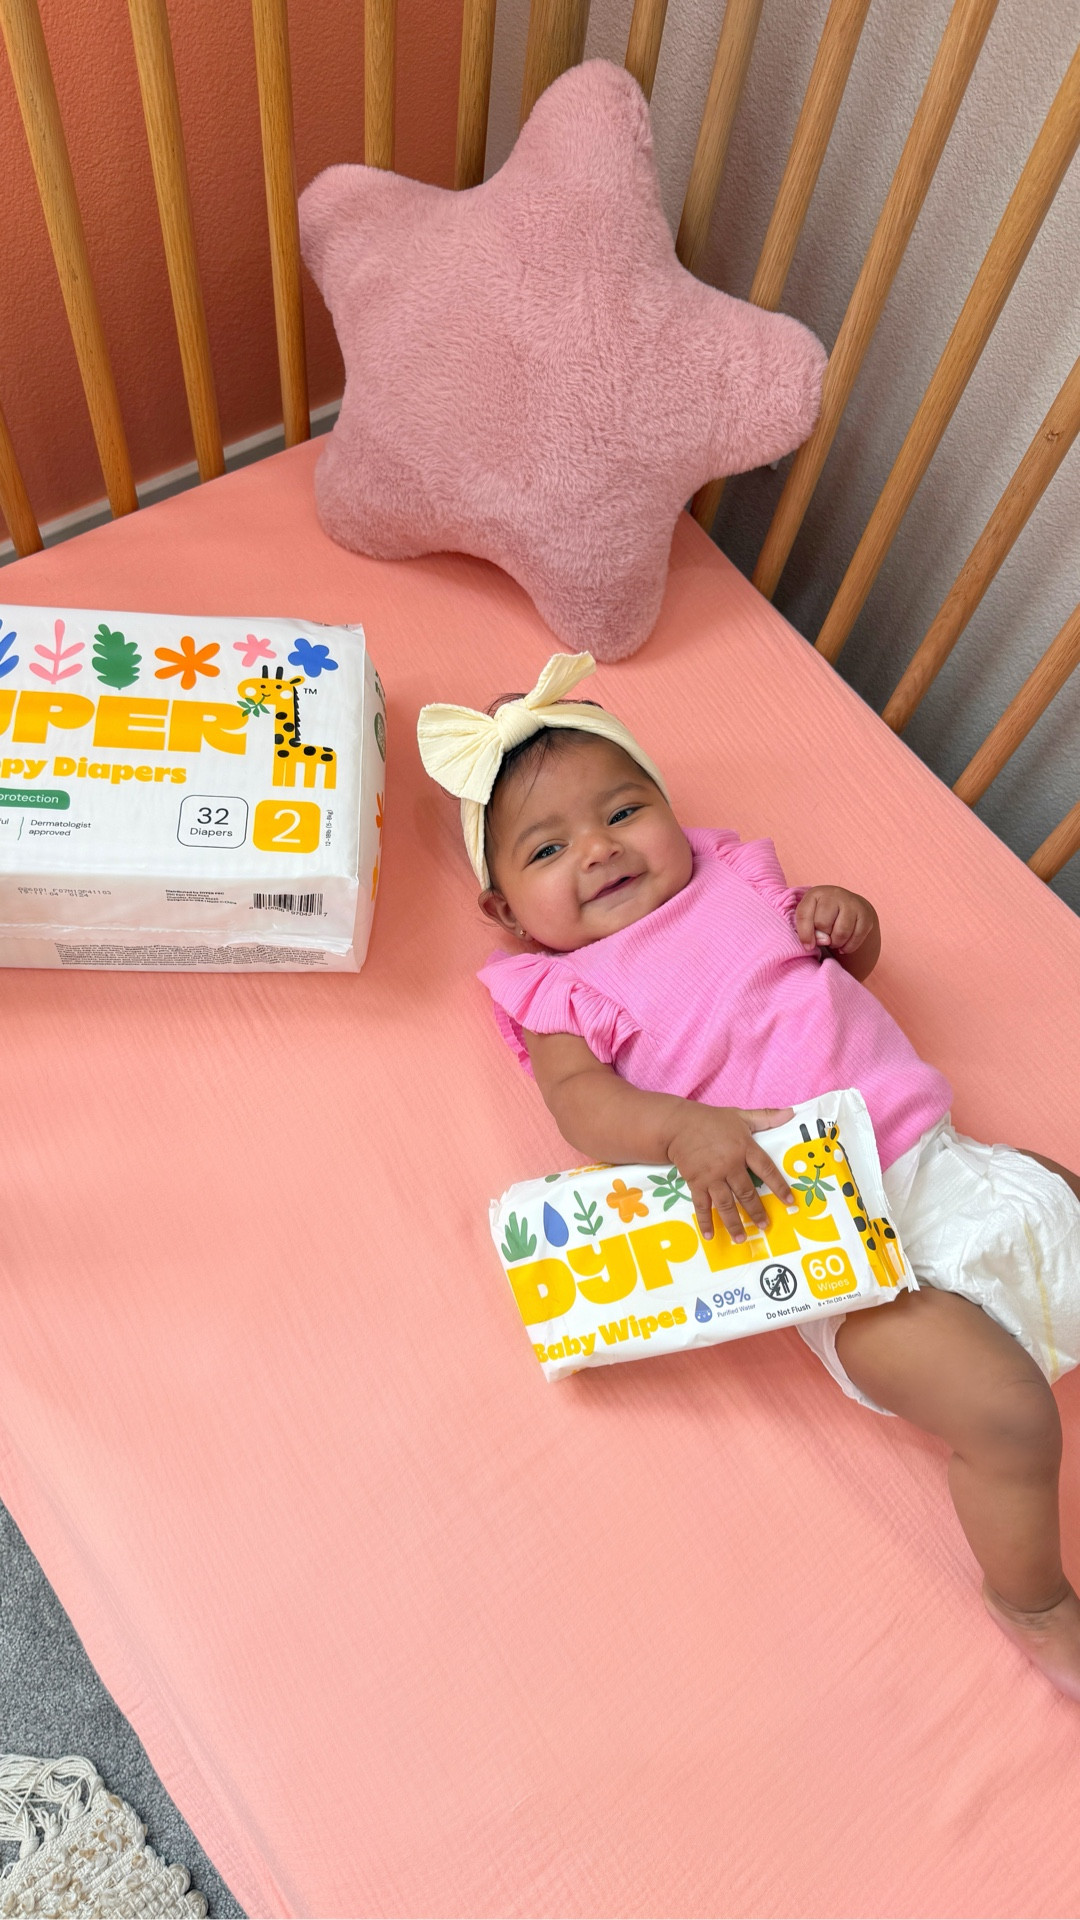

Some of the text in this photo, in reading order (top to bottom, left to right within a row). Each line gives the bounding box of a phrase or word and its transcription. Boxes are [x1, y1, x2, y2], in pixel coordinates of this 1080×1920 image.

[303, 687, 318, 695] TM
[0, 756, 187, 785] py Diapers
[30, 819, 92, 829] Dermatologist
[197, 807, 229, 825] 32
[190, 827, 233, 838] Diapers
[271, 808, 301, 844] 2
[808, 1254, 845, 1281] 60
[817, 1278, 850, 1292] Wipes
[712, 1286, 751, 1309] 99%
[717, 1304, 756, 1318] Purified Water
[766, 1303, 811, 1320] Do Not Flush
[532, 1306, 688, 1363] Baby Wipes
